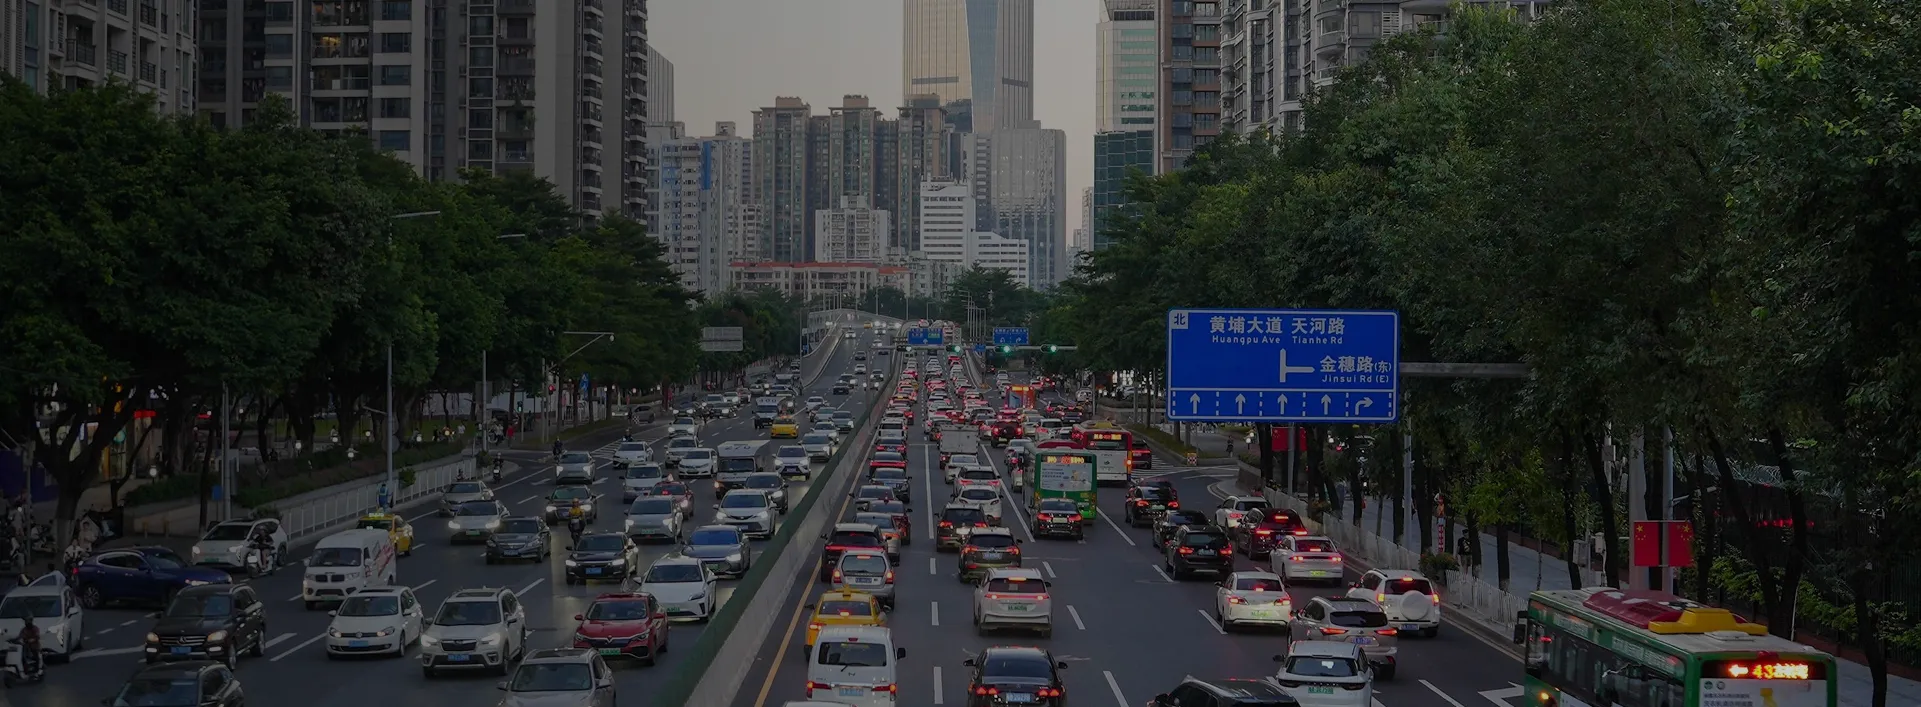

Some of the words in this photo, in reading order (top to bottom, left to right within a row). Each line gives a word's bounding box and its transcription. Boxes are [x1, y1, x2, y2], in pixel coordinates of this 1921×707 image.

[1174, 313, 1186, 325] 北
[1210, 316, 1283, 334] 黄埔大道
[1291, 317, 1345, 335] 天河路
[1212, 335, 1259, 345] Huangpu
[1262, 336, 1281, 344] Ave
[1292, 336, 1328, 344] Tianhe
[1330, 336, 1343, 344] Rd
[1322, 375, 1357, 383] Jinsui
[1360, 375, 1372, 383] Rd
[1375, 375, 1389, 383] (E)
